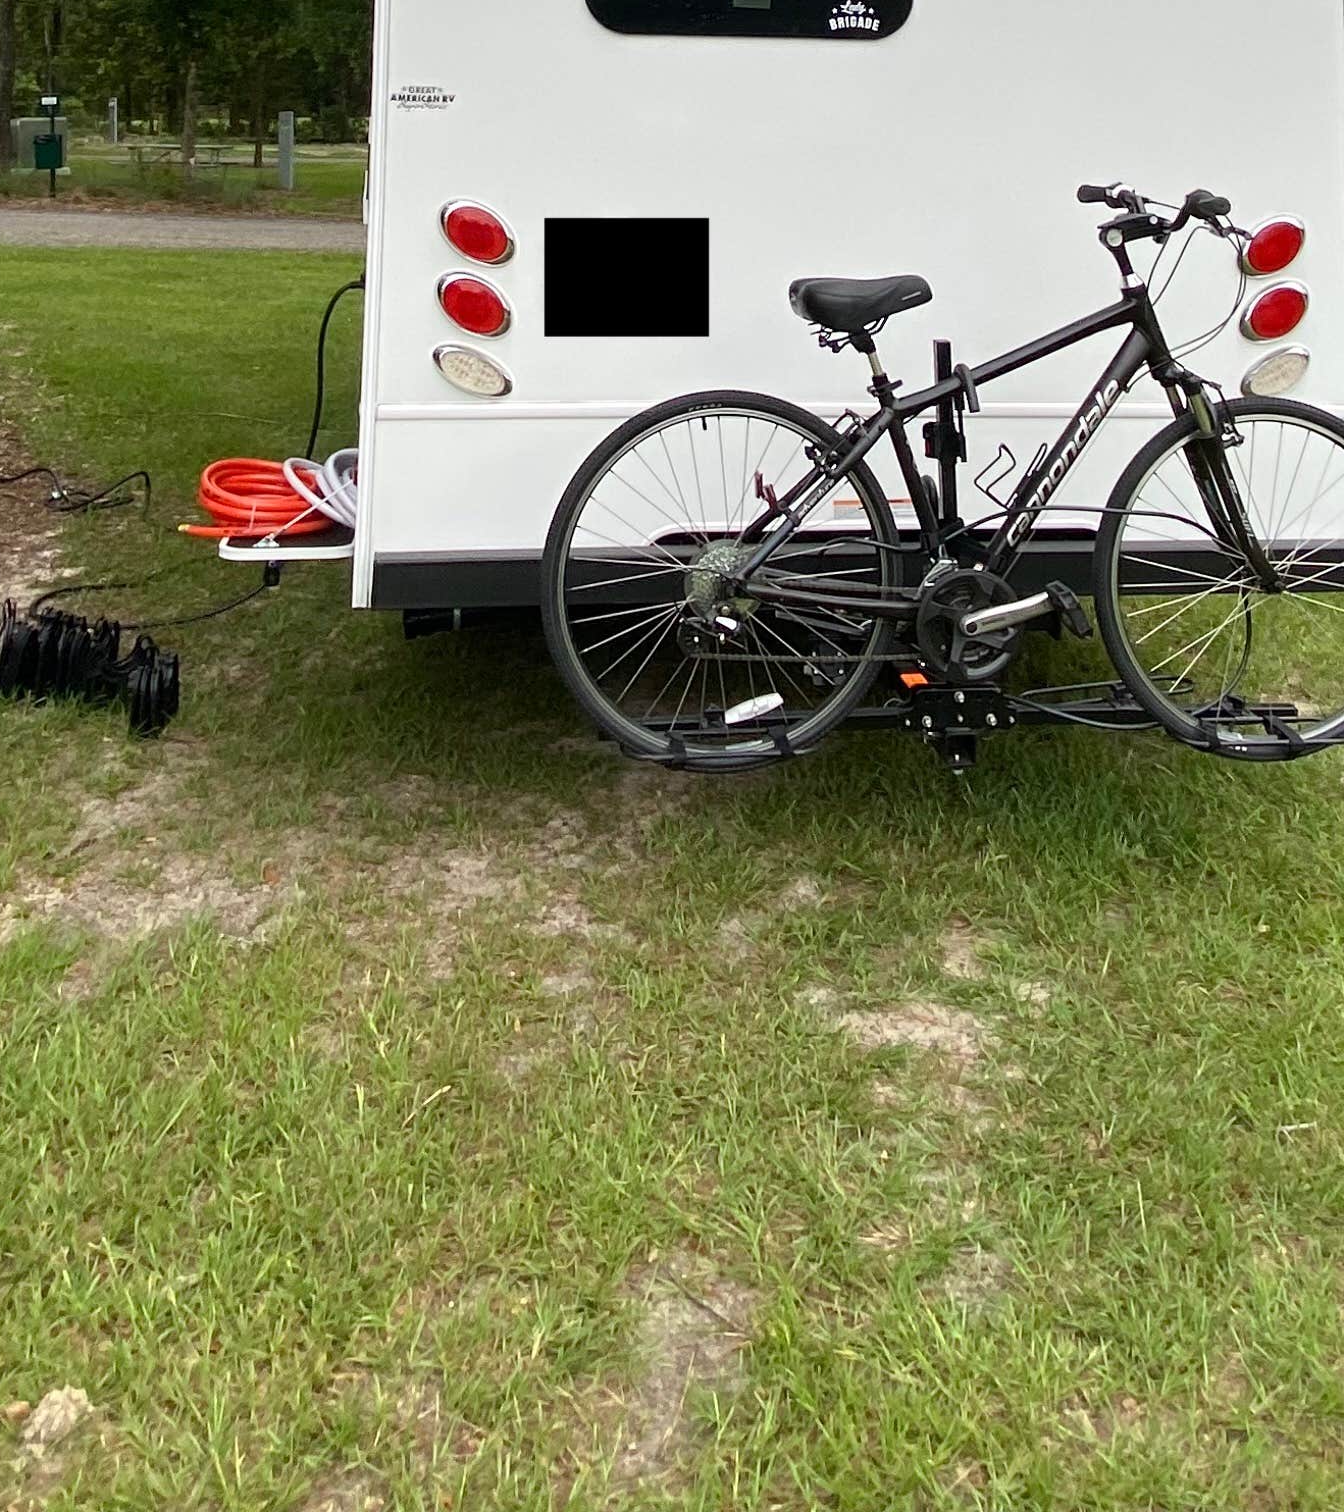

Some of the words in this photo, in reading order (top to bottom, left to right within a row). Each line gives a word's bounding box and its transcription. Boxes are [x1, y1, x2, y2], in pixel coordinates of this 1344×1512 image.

[829, 16, 881, 31] BRIGADE
[391, 94, 440, 102] AMERICAN
[442, 94, 456, 102] RV
